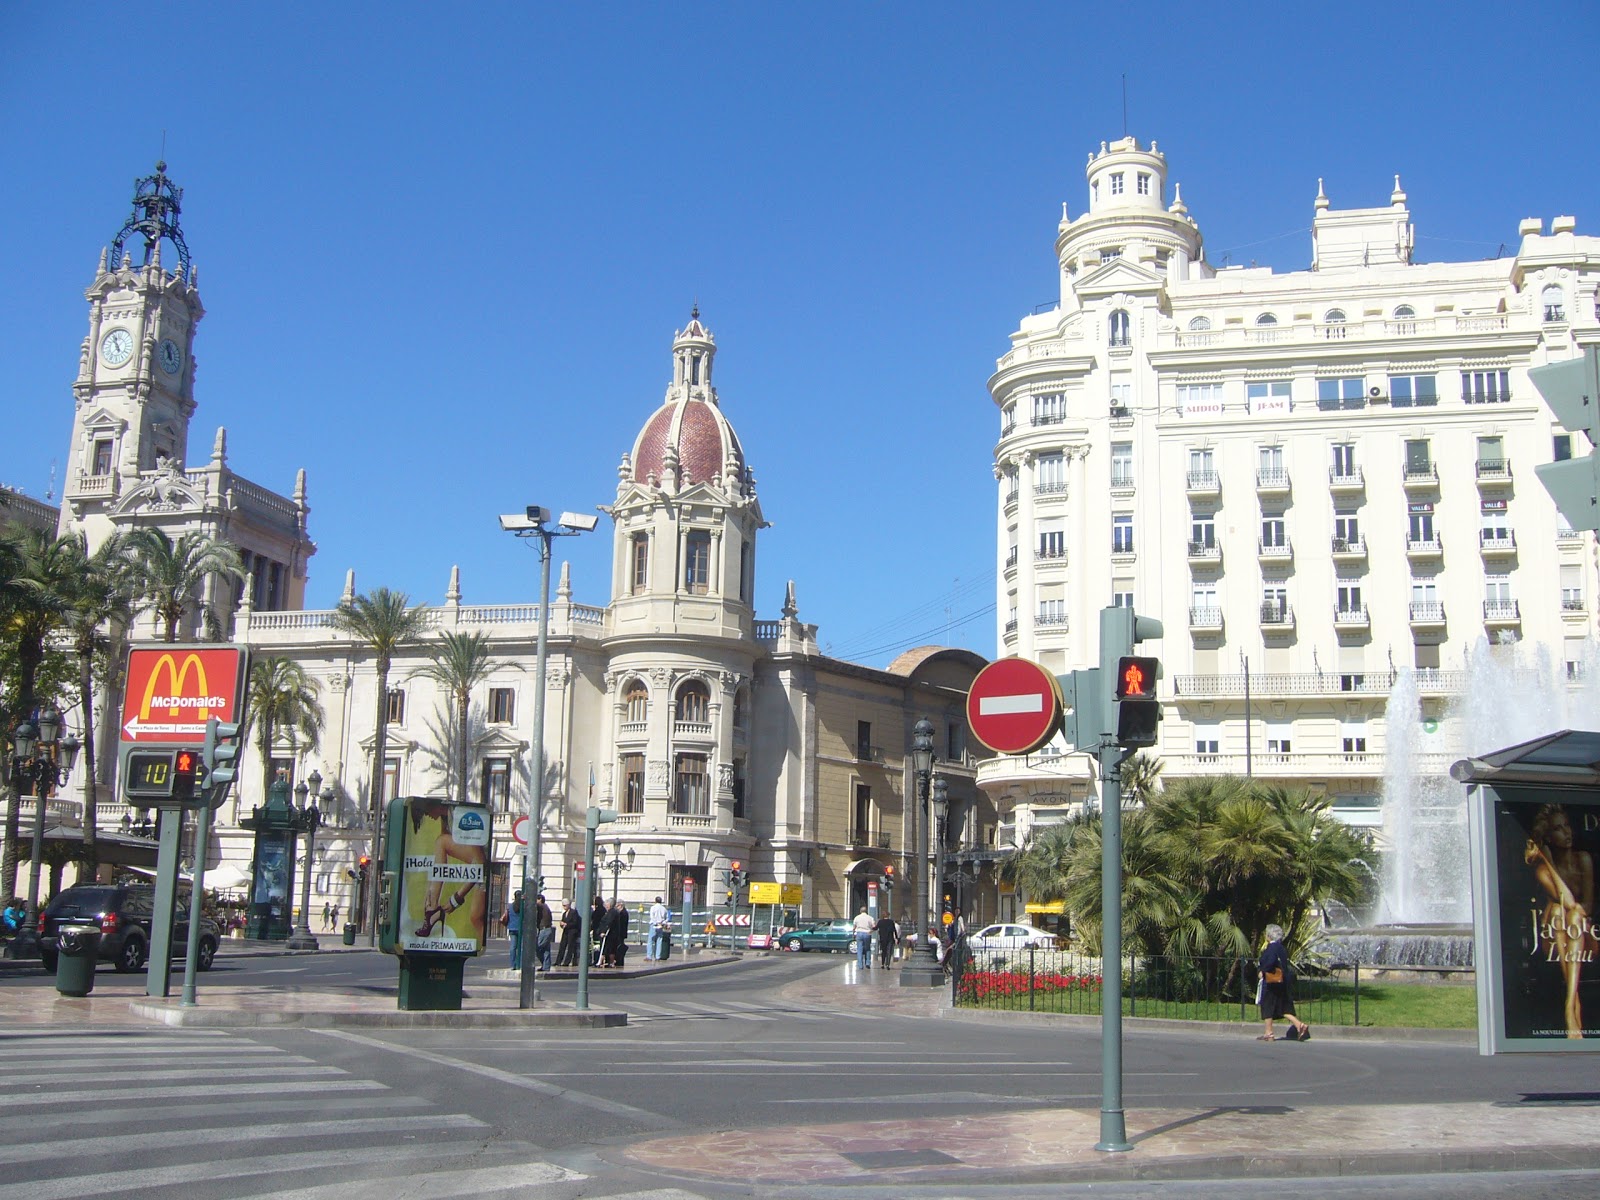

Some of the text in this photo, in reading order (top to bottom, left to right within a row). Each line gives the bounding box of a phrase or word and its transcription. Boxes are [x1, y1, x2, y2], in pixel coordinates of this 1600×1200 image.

[1185, 405, 1219, 413] AUDIO
[151, 696, 225, 708] McDonald's
[406, 857, 433, 868] ¡Hola
[433, 866, 481, 879] PIERNAS!
[409, 941, 473, 951] moda PRIMAVERA
[1546, 942, 1594, 962] L'eau
